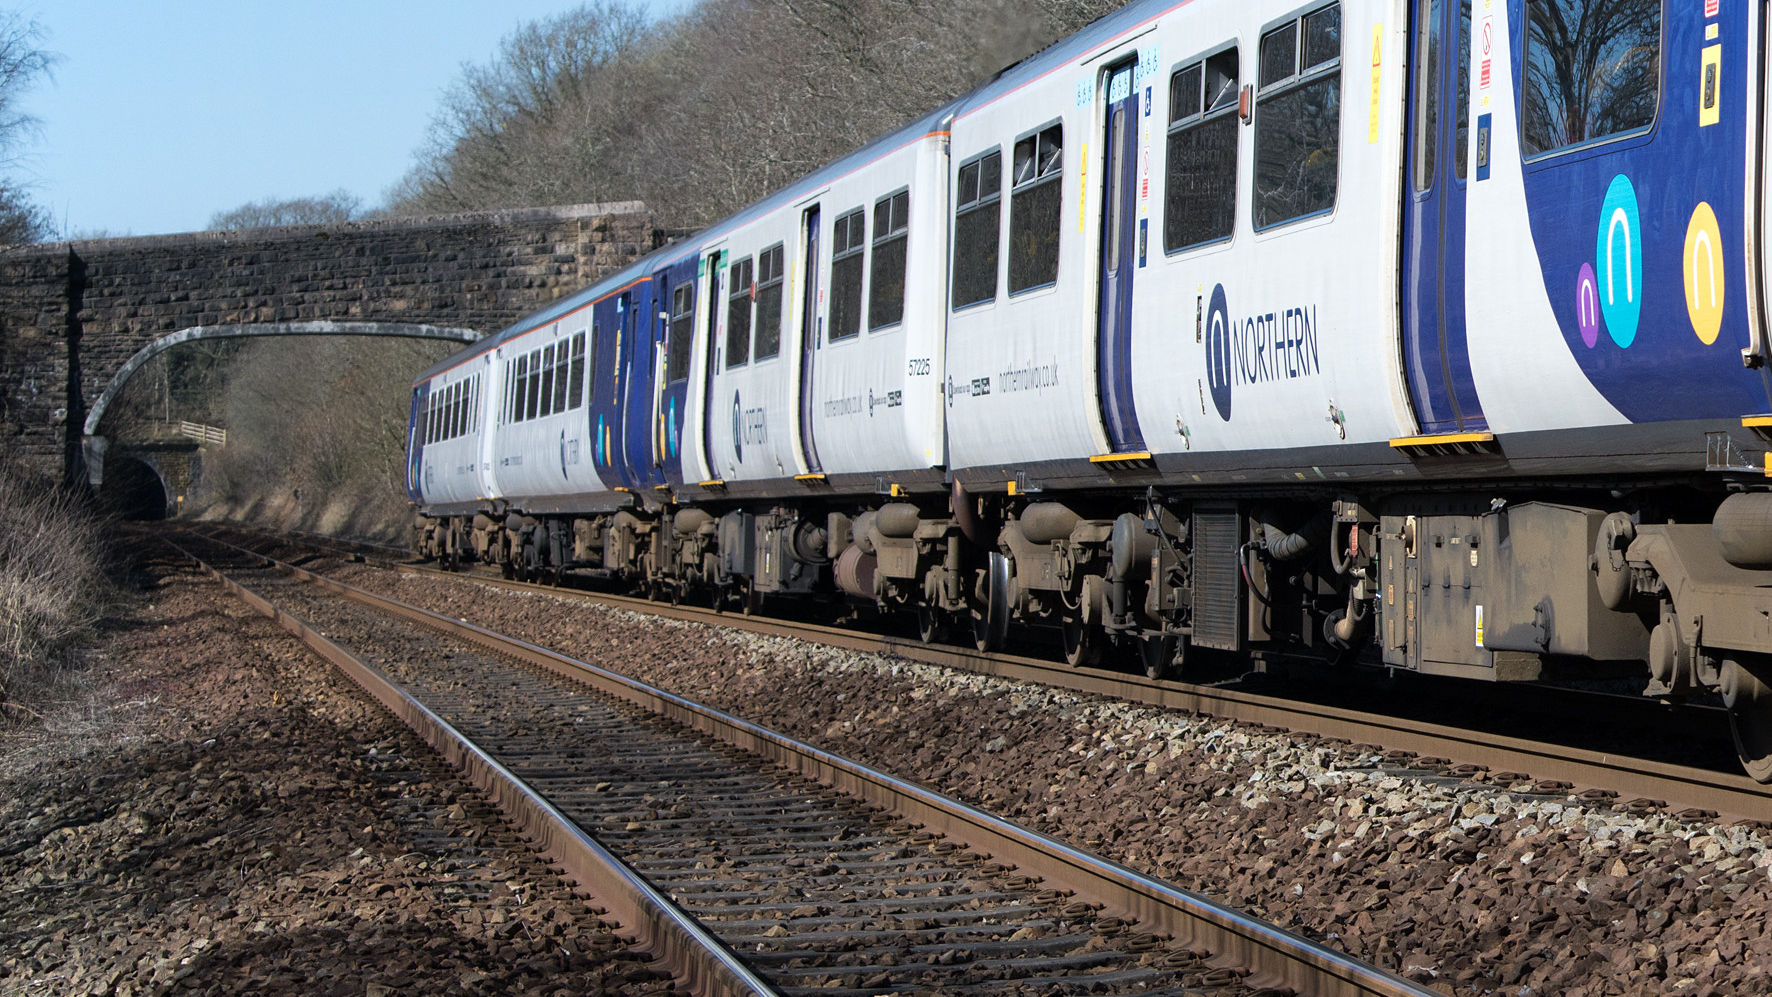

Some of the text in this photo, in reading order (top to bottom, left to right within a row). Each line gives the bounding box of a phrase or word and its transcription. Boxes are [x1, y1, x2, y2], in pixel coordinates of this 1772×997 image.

[1233, 303, 1320, 387] NORTHERN
[908, 358, 931, 377] 57225
[999, 355, 1060, 397] northernrailway.co.uk
